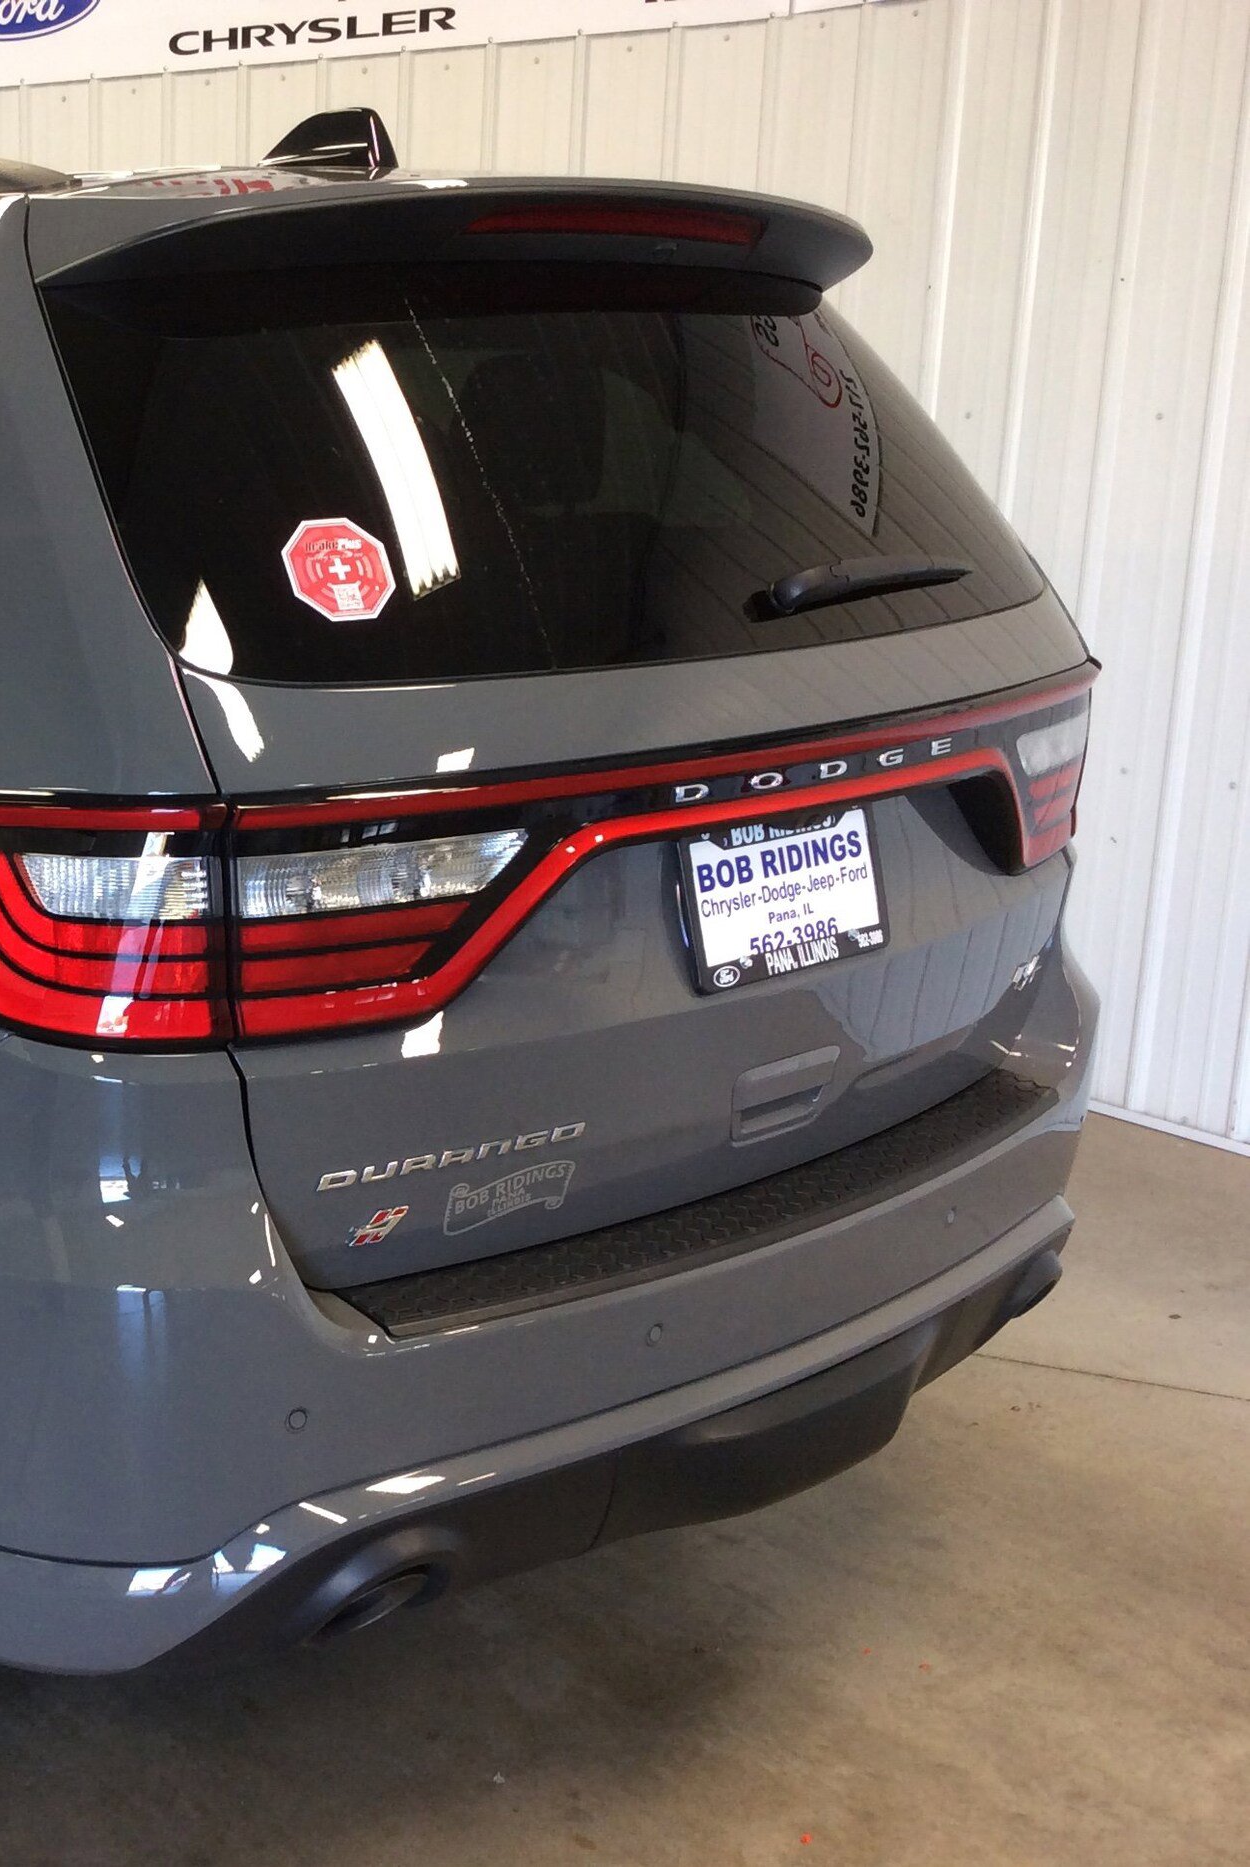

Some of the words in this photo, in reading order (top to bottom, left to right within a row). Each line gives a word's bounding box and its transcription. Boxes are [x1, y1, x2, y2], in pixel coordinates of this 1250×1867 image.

[167, 6, 458, 56] CHRYSLER
[674, 737, 953, 803] DODGE
[696, 854, 754, 893] BOB
[760, 830, 862, 879] RIDINGS
[701, 863, 869, 918] Chrysler-Dodge-Jeep-Ford
[768, 908, 801, 924] Pana,
[803, 903, 814, 916] IL
[798, 936, 840, 974] ILLINOIS
[316, 1121, 586, 1192] DURANGO
[454, 1189, 489, 1215] BOB
[496, 1163, 567, 1197] RIDINGS
